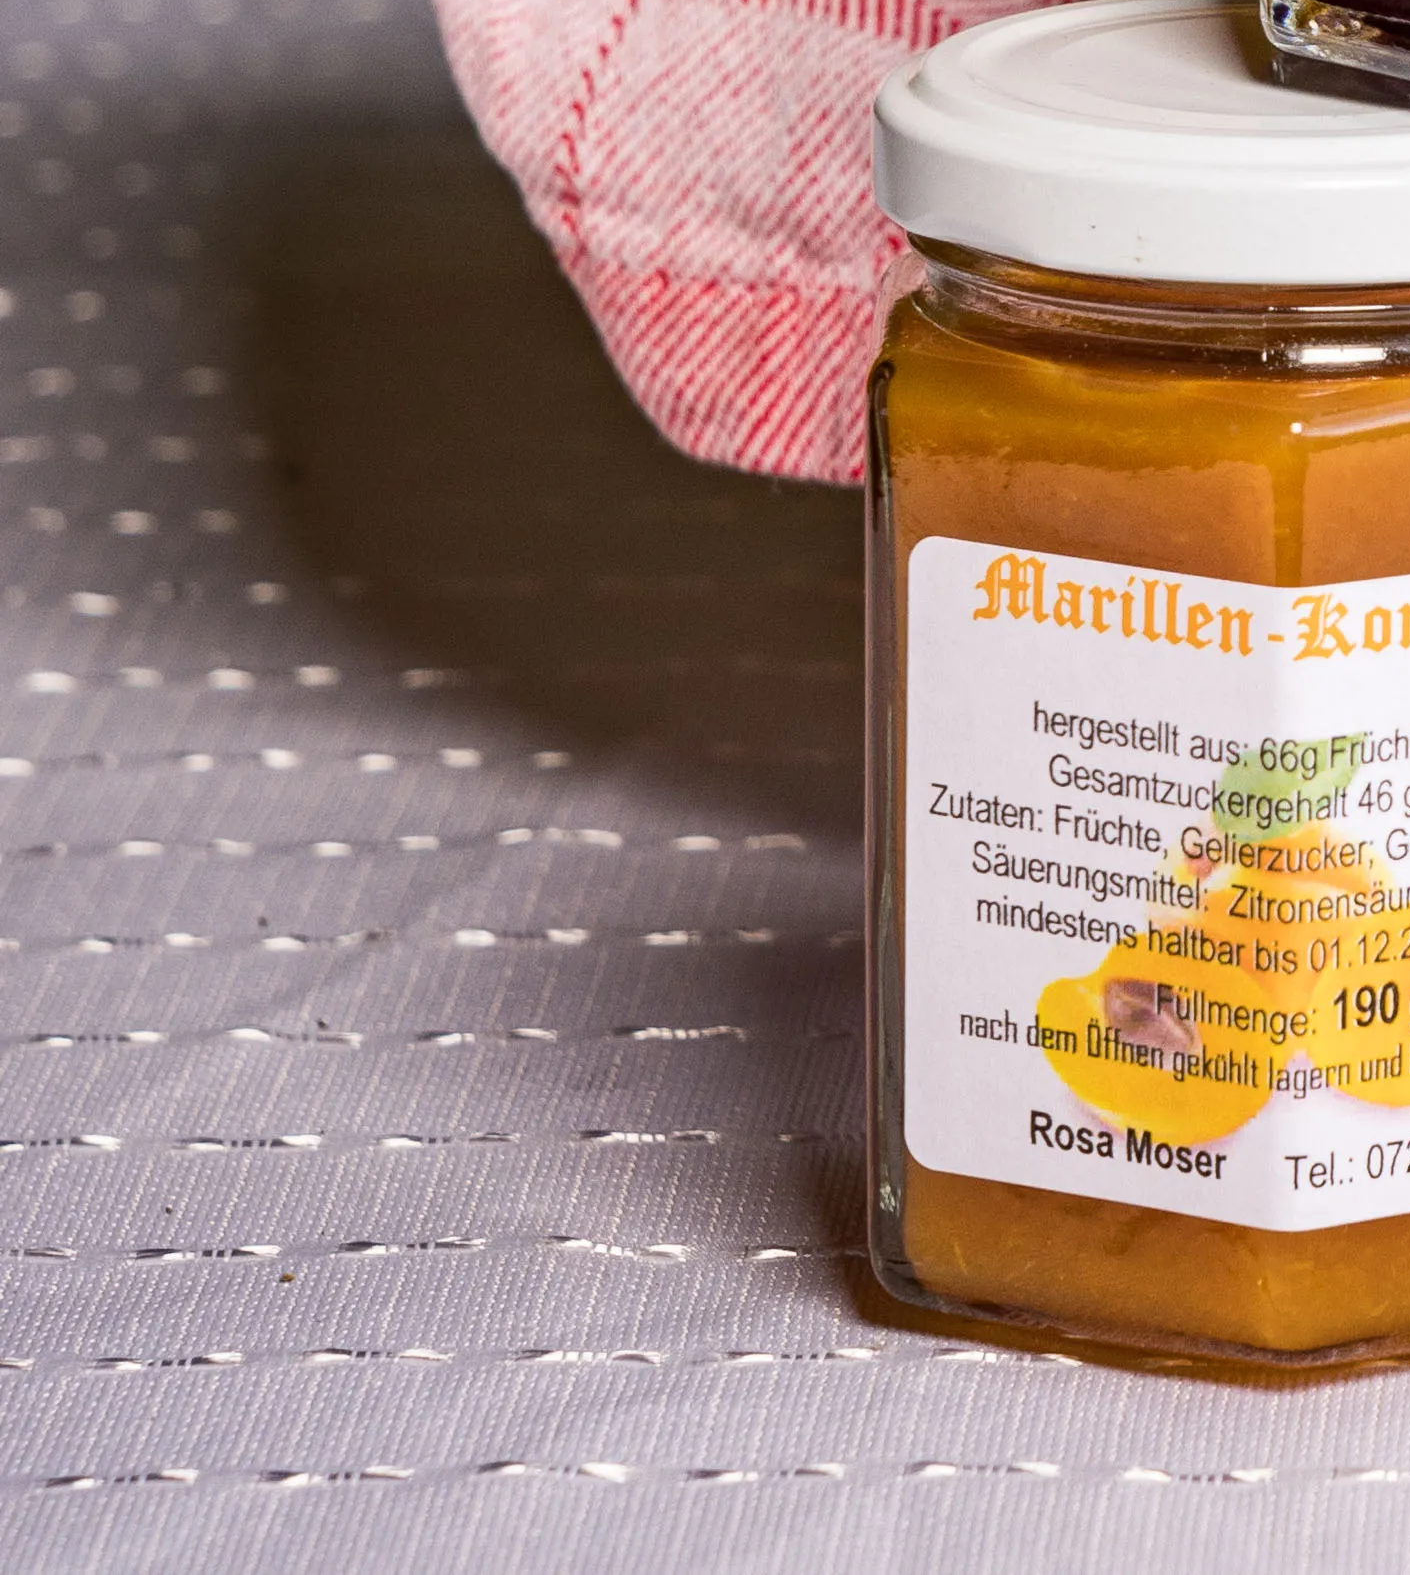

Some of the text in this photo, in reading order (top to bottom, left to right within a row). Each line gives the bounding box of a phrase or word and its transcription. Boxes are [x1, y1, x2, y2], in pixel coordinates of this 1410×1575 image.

[1033, 700, 1180, 757] hergestellt
[1189, 734, 1248, 768] aus:
[1259, 737, 1319, 781] 66g
[929, 782, 1043, 833] Zutaten:
[1054, 803, 1168, 860] Früchte,
[1180, 826, 1376, 873] Gelierzucker;
[971, 840, 1210, 911] Säuerungsmittel:
[976, 894, 1138, 949] mindestens
[1148, 927, 1246, 967] haltbar
[1255, 938, 1298, 975] bis
[1156, 982, 1318, 1046] Füllmenge:
[1333, 981, 1400, 1030] 190
[1030, 1109, 1114, 1159] Rosa
[1125, 1126, 1228, 1180] Moser
[1284, 1151, 1356, 1191] Tel.:
